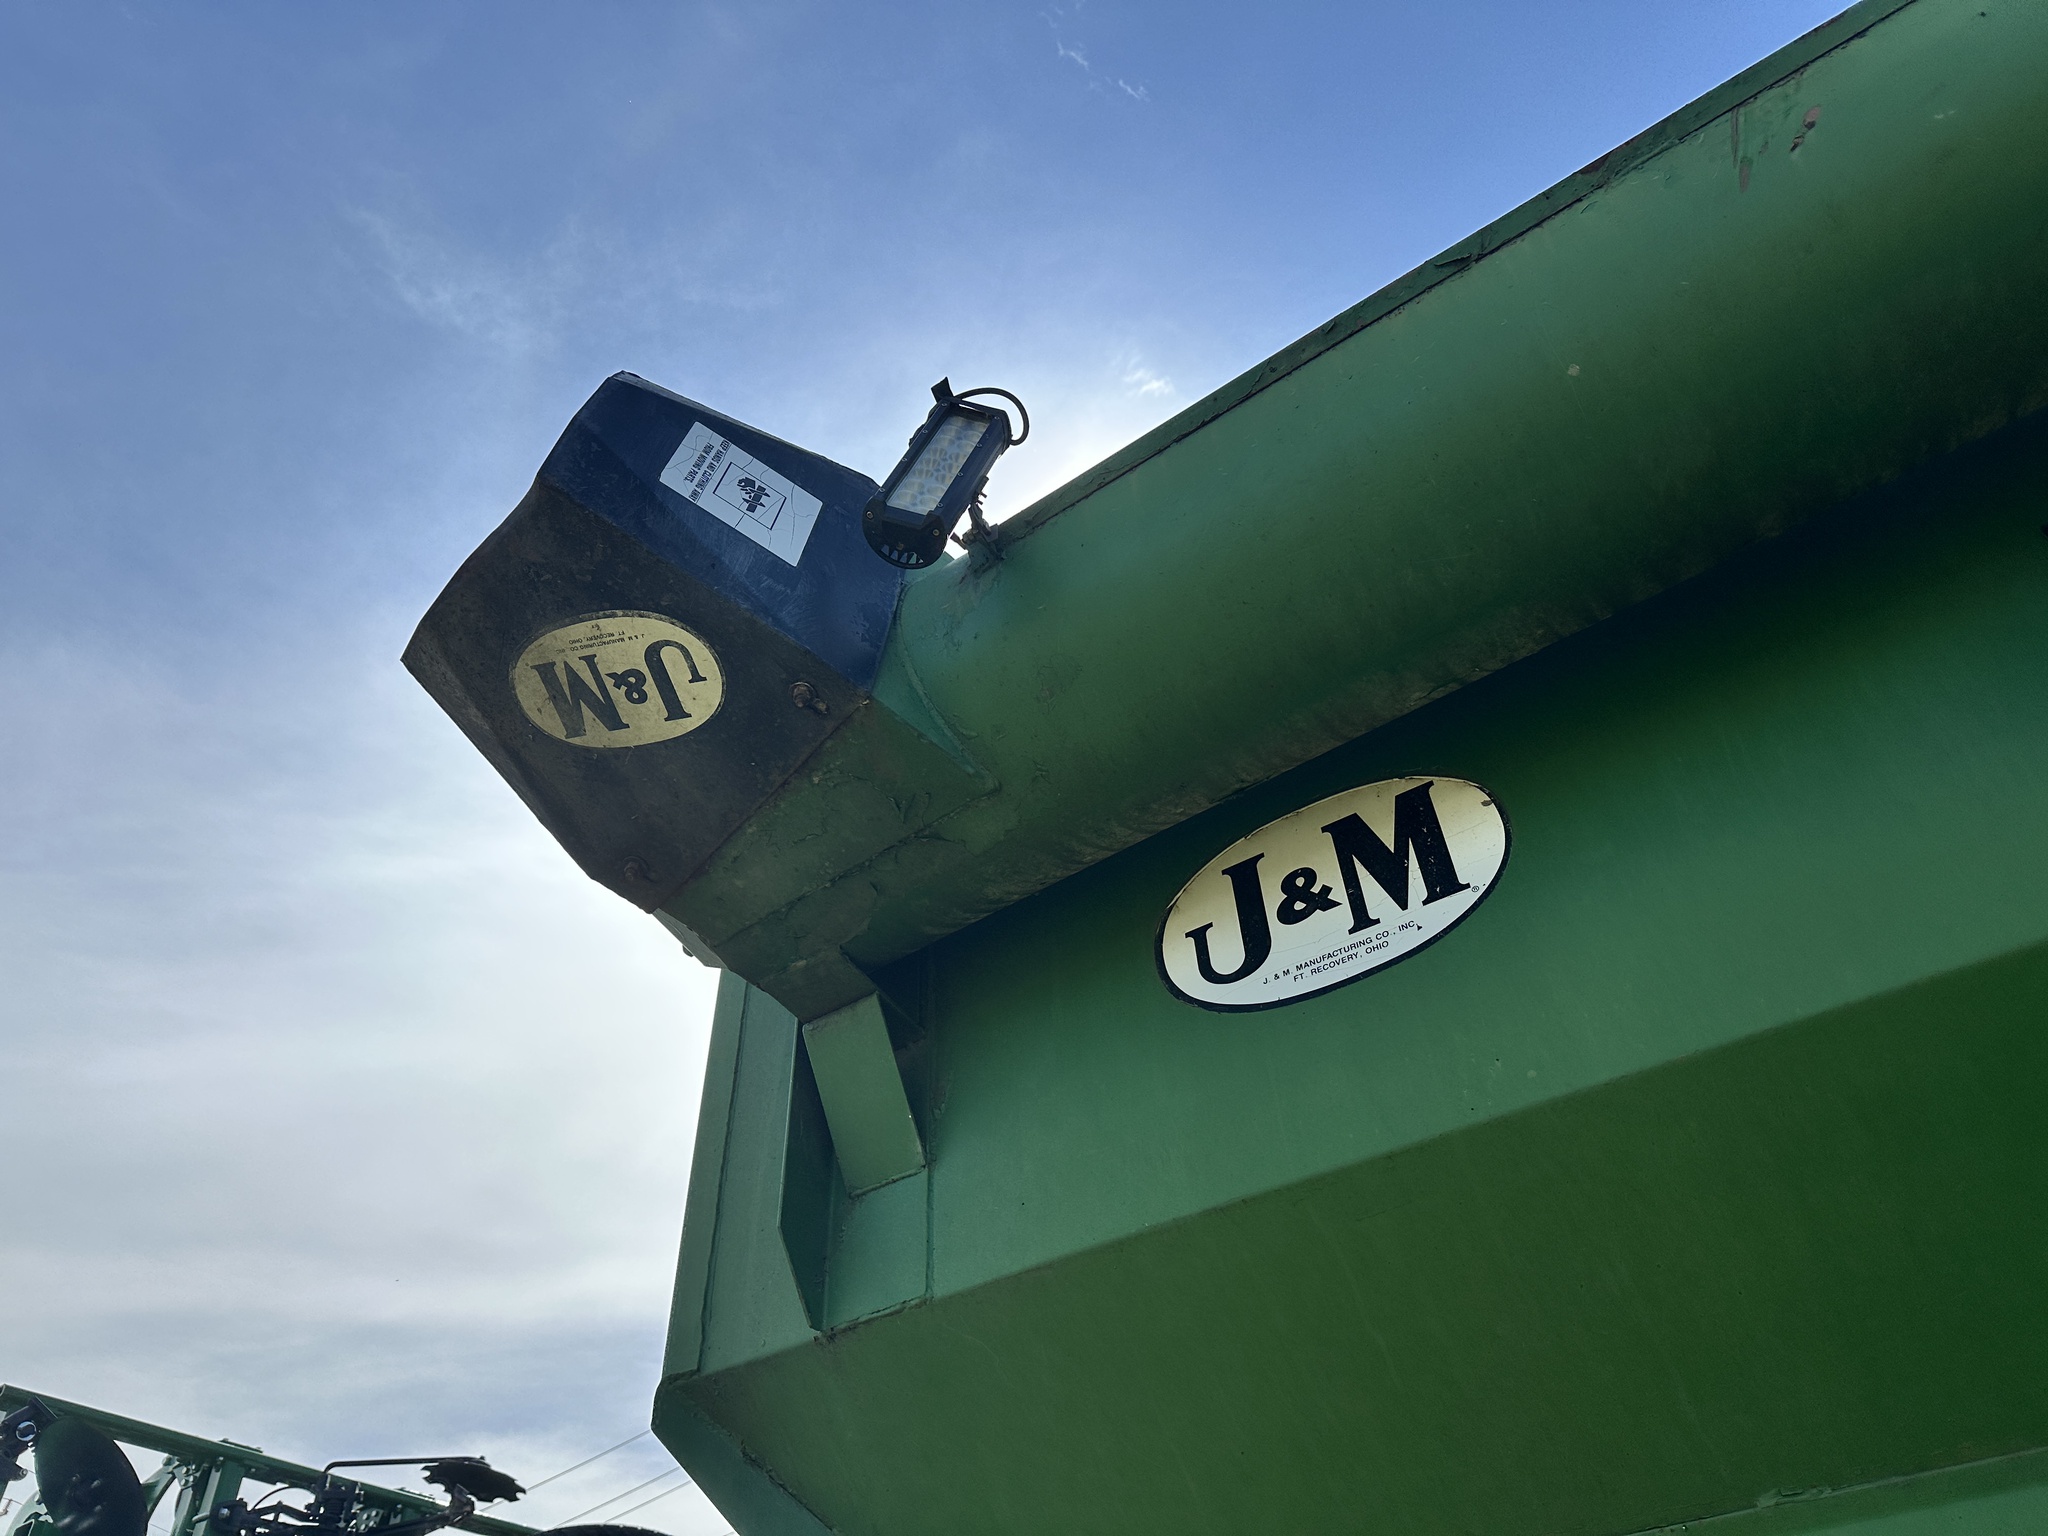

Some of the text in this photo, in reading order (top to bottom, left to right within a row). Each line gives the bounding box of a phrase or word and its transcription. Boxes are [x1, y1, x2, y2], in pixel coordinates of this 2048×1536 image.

[702, 442, 715, 456] FROM
[711, 448, 725, 464] HANDS
[692, 452, 708, 470] MOVING
[706, 461, 717, 472] AND
[695, 470, 712, 490] CLOTHING
[688, 488, 700, 502] AWAY
[1295, 937, 1373, 972] MANUFACTURING
[1310, 951, 1363, 976] RECOVERY,
[1365, 940, 1389, 955] OHIO
